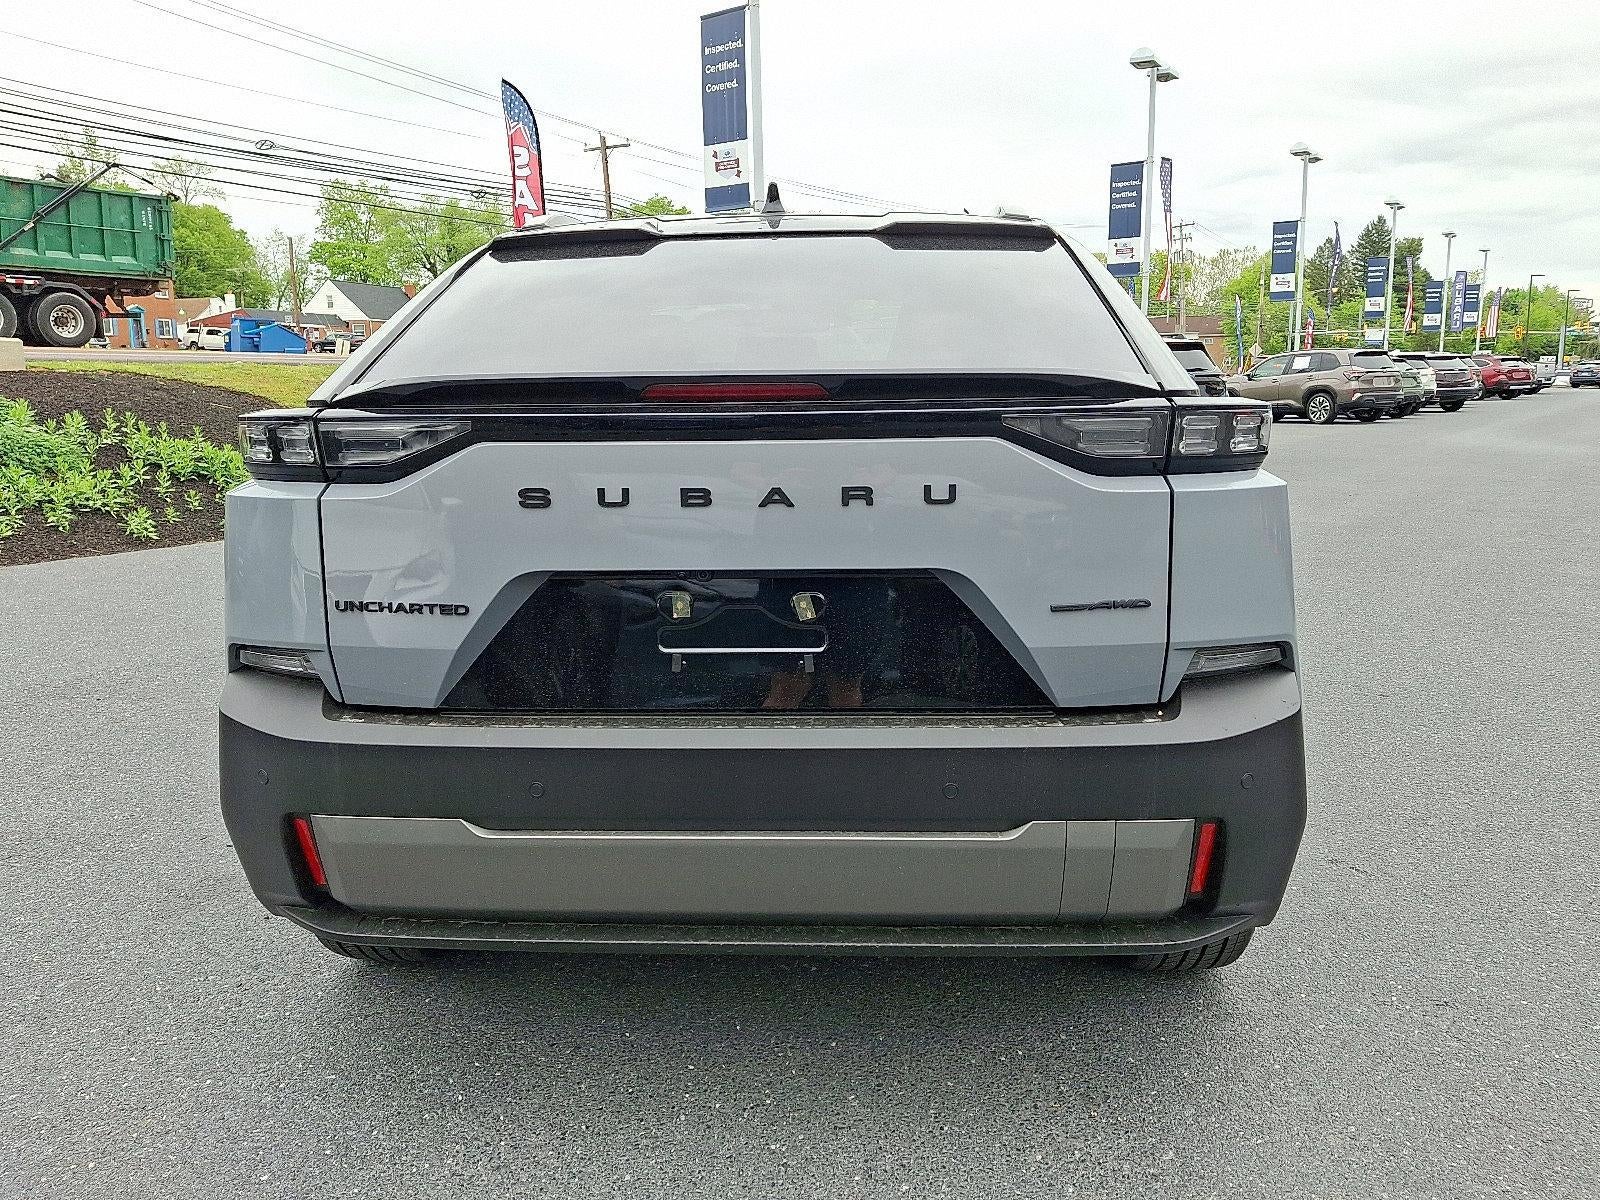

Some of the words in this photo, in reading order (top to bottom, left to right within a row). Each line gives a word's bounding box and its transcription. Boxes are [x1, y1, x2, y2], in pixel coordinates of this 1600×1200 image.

[705, 38, 743, 55] Inspected.
[705, 59, 740, 74] Certified.
[705, 78, 739, 93] Covered.
[1112, 179, 1141, 188] Inspected.
[1452, 282, 1463, 328] SUBARU
[518, 484, 957, 509] SUBARU
[334, 600, 470, 616] UNCHARTED
